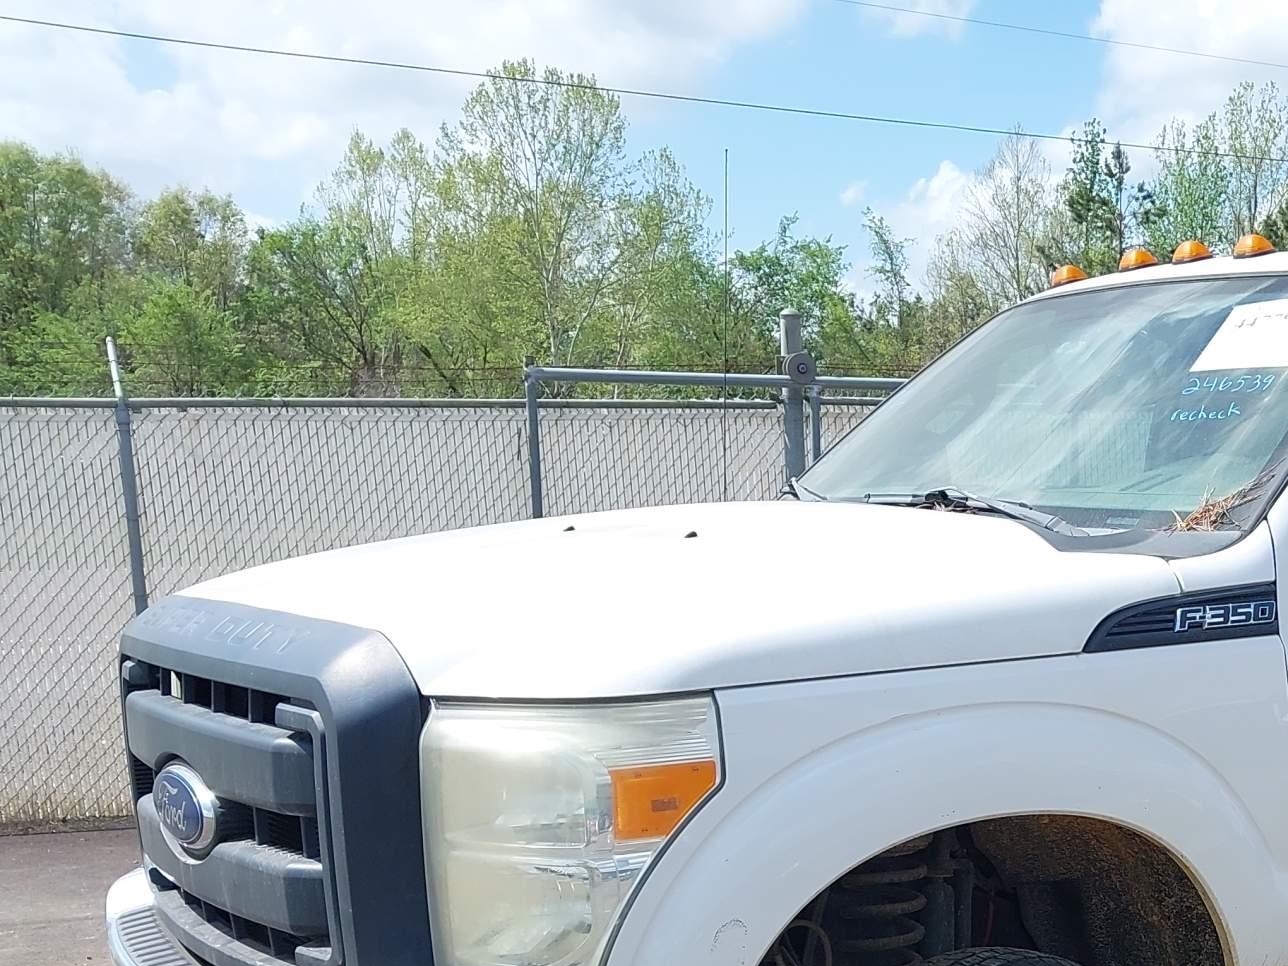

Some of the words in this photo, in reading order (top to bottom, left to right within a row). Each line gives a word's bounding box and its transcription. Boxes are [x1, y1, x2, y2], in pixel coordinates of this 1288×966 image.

[1181, 374, 1276, 396] 246539
[1170, 401, 1241, 421] recheck
[158, 780, 188, 832] Ford
